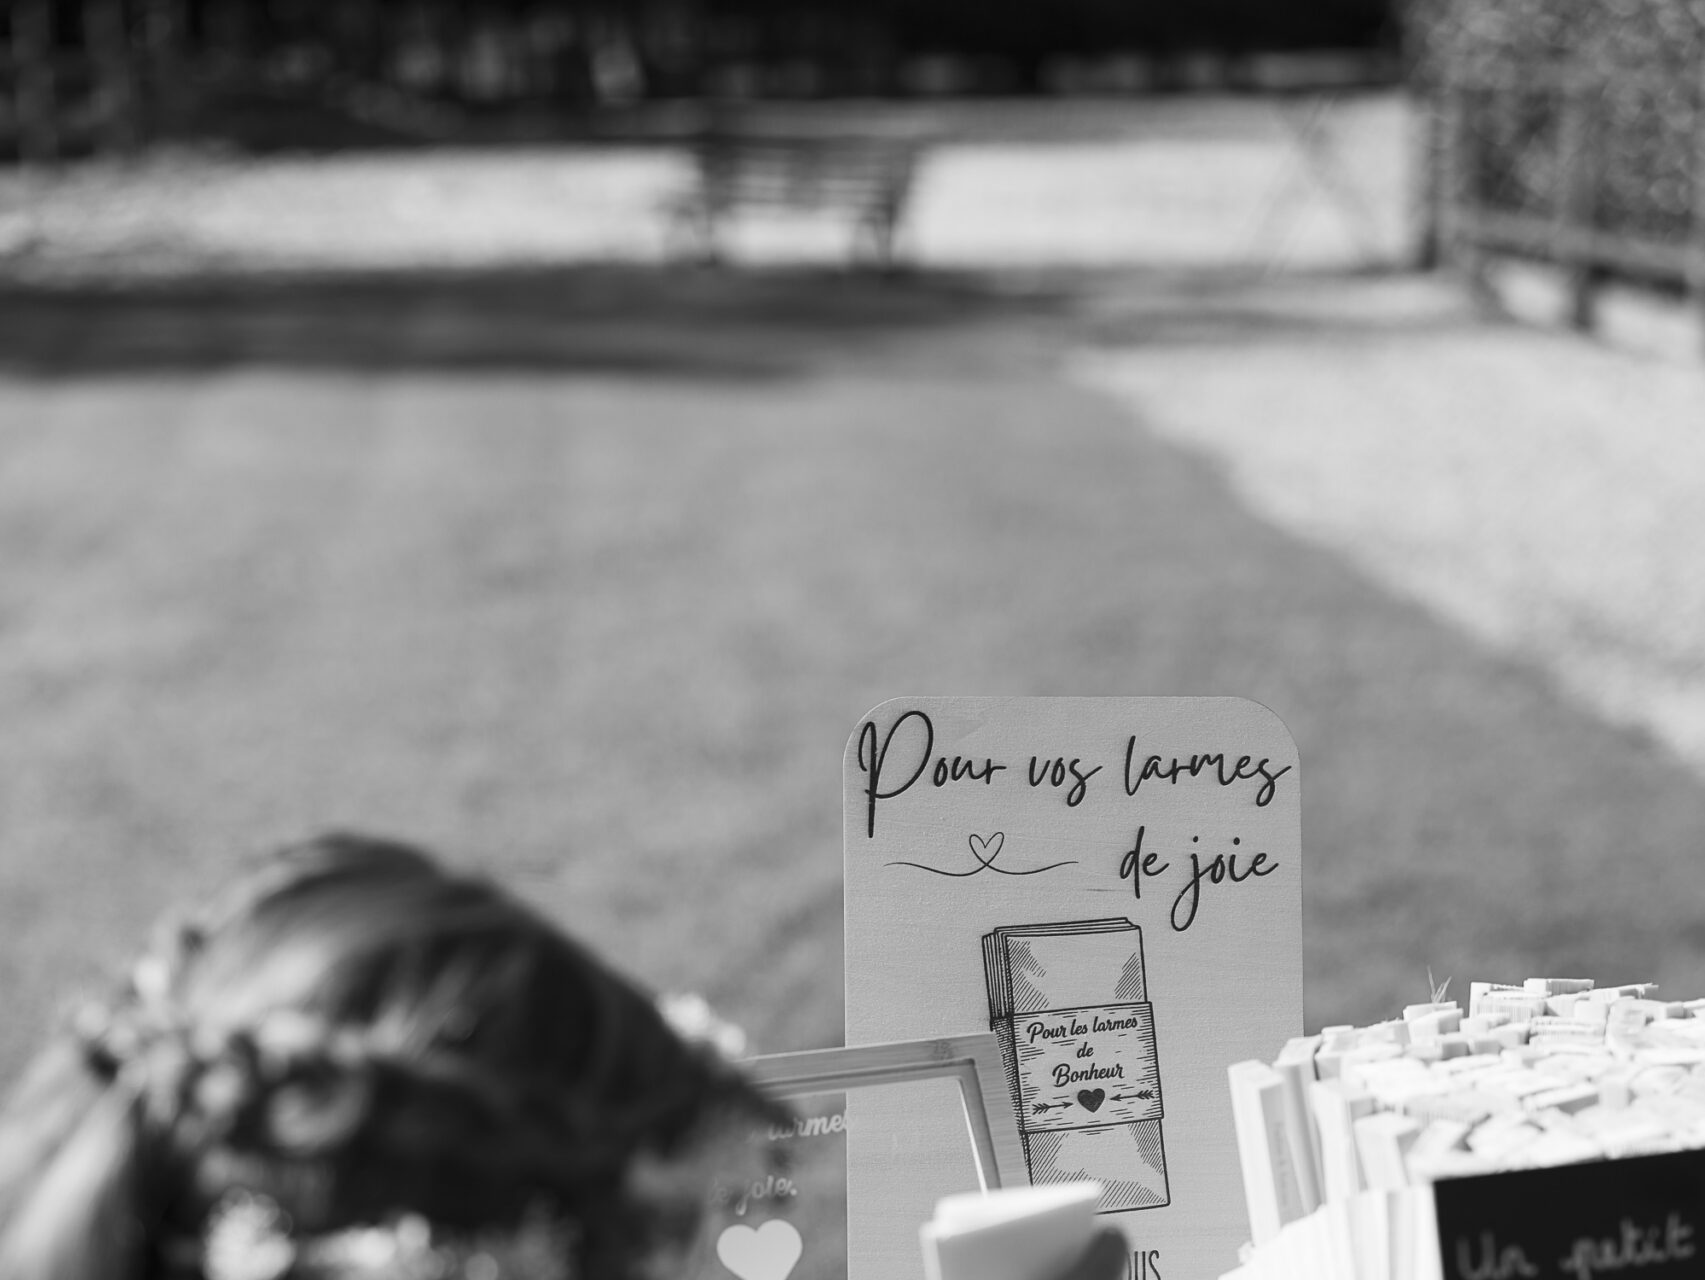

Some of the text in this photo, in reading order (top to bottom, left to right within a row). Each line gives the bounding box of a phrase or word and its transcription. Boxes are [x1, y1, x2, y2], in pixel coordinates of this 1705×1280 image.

[858, 710, 1293, 838] Pour vos larmes
[1119, 825, 1279, 932] de joie
[1026, 1015, 1138, 1044] Pour les larmes
[1076, 1041, 1094, 1058] de
[1052, 1062, 1125, 1087] Bonheur
